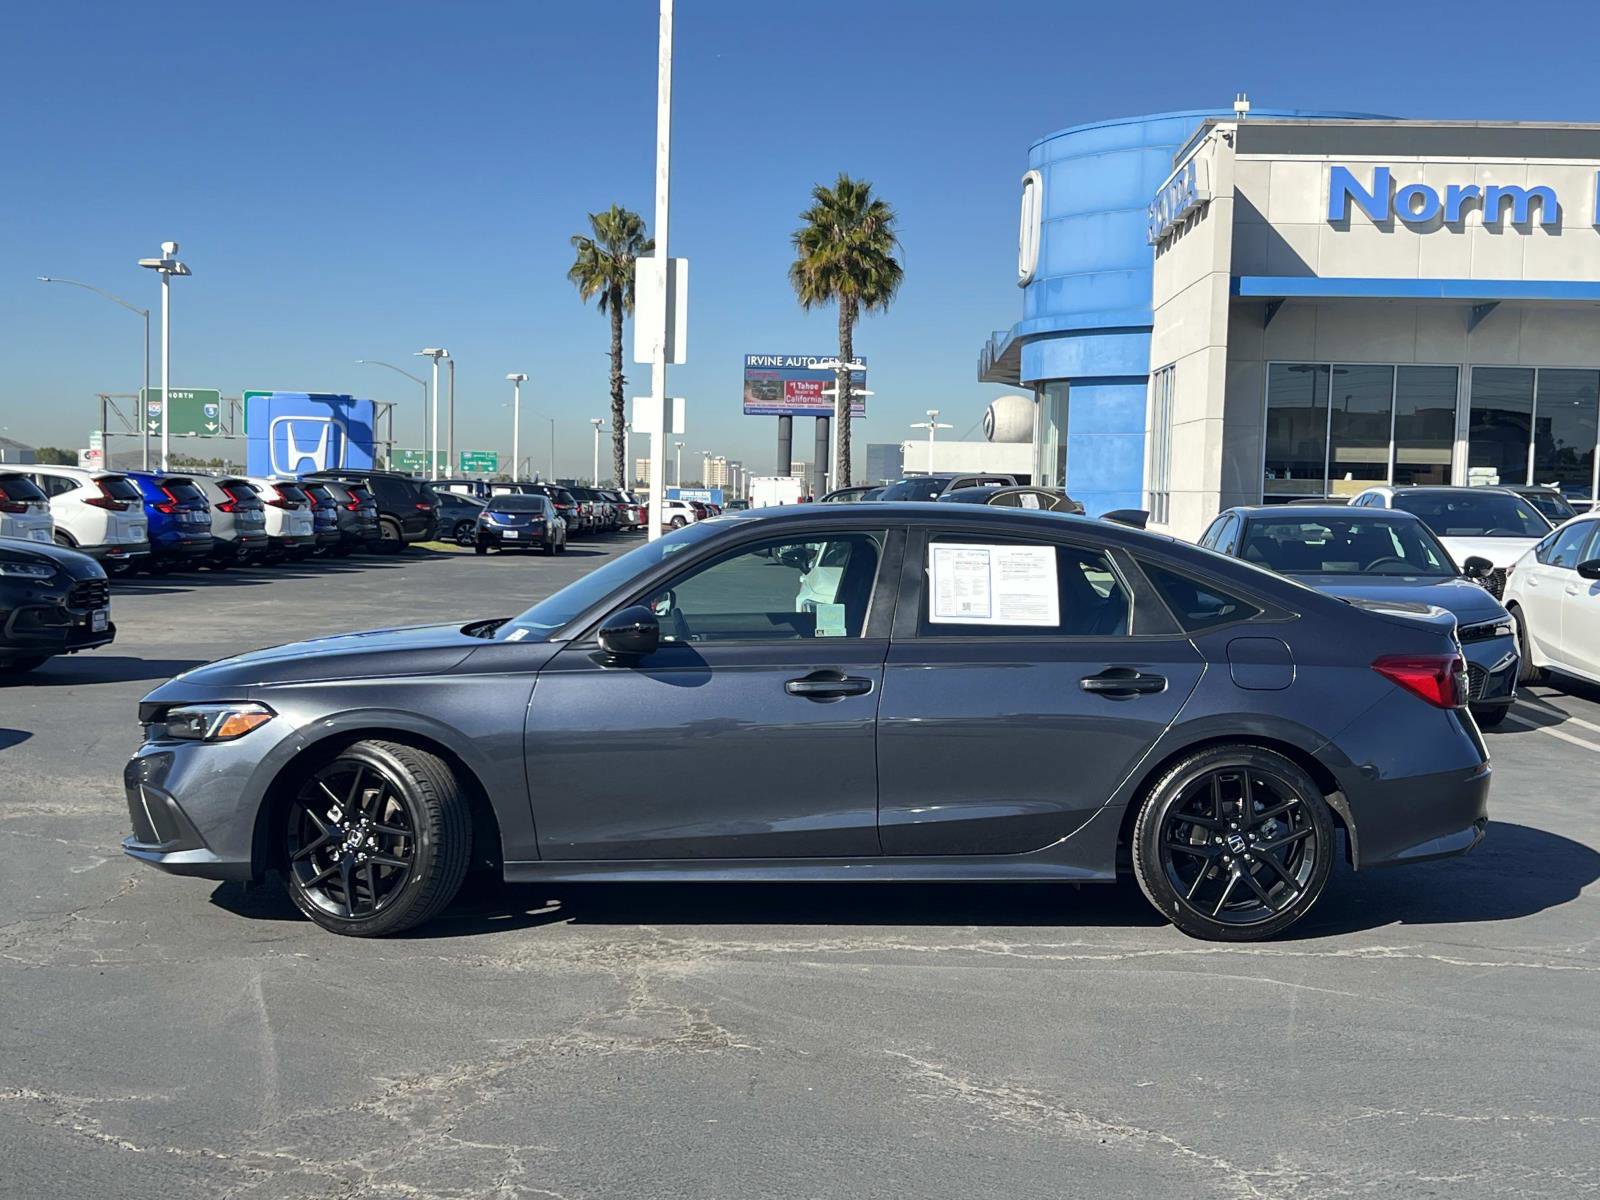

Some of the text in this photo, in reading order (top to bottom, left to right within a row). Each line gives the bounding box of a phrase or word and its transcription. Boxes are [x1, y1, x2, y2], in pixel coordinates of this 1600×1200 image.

[1327, 165, 1558, 224] Norm
[747, 355, 783, 366] IRVINE
[785, 356, 817, 367] AUTO
[797, 381, 819, 390] Tahoe
[786, 395, 823, 404] California
